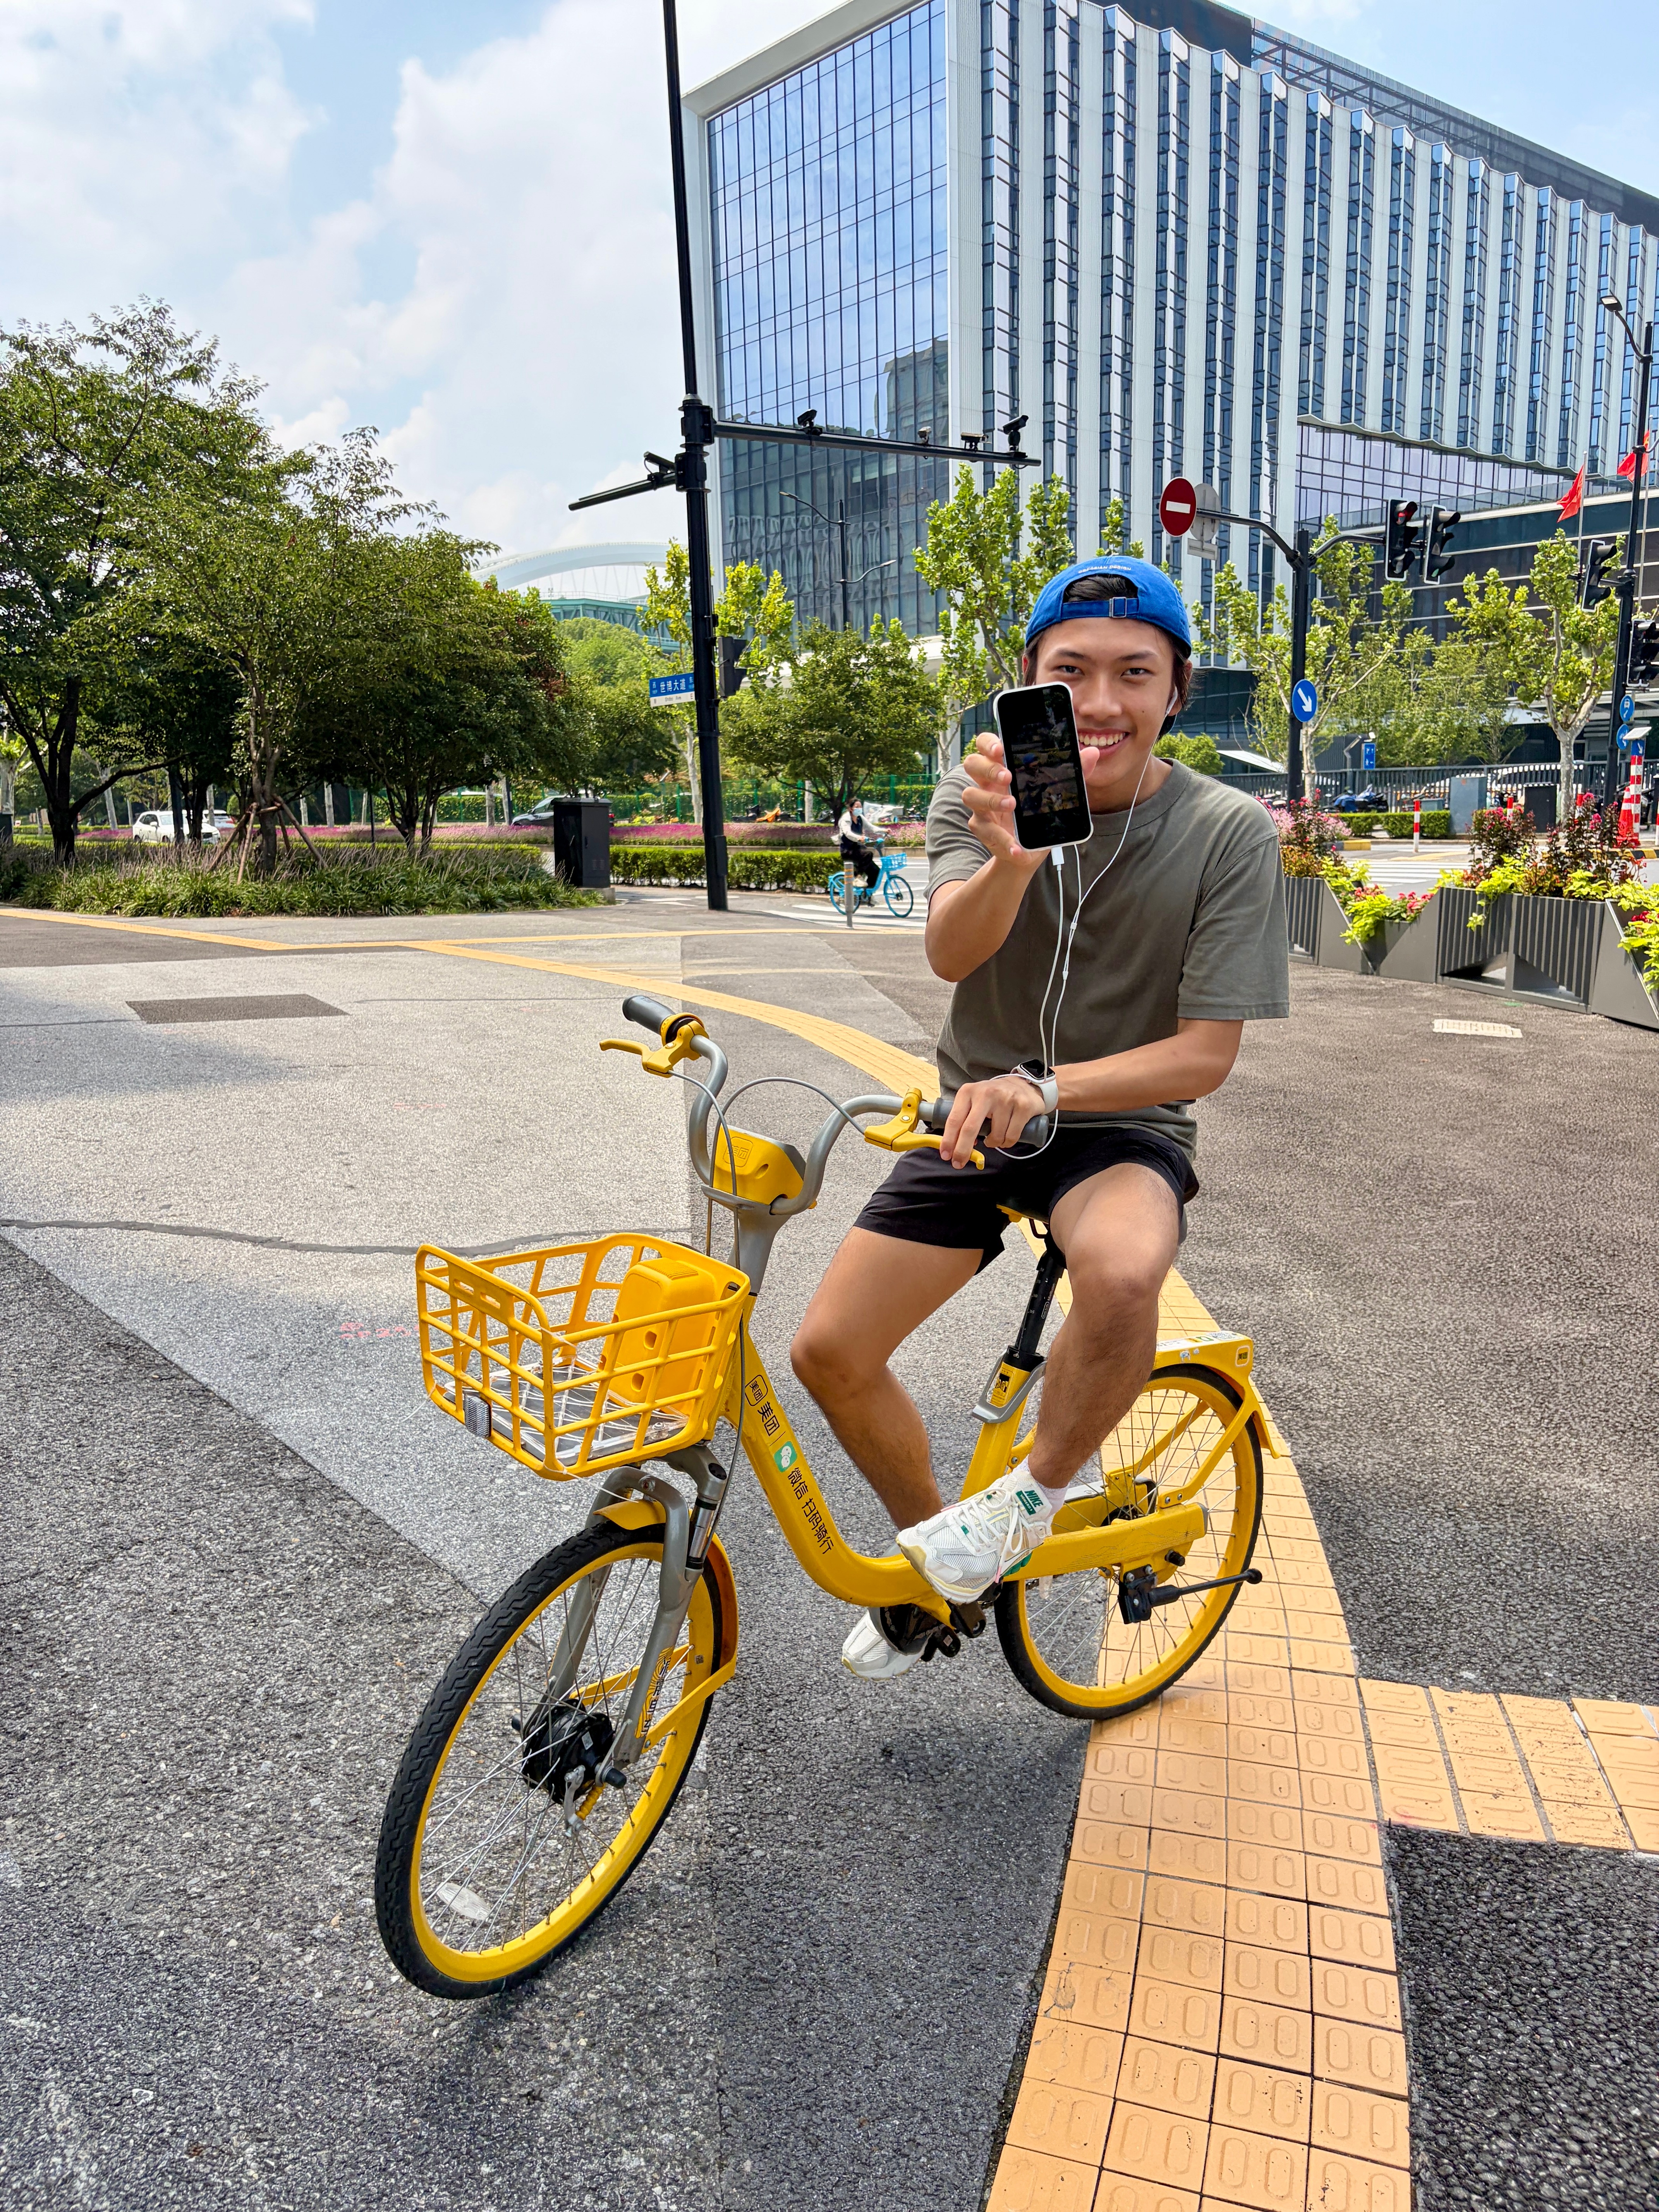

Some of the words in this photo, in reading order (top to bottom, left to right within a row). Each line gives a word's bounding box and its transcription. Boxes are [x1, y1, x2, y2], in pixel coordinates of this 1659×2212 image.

[660, 678, 686, 692] 世博大道
[749, 1380, 764, 1401] 美团
[757, 1401, 780, 1437] 美团
[1025, 1490, 1043, 1507] NIKE
[787, 1467, 809, 1501] 微信
[801, 1498, 835, 1554] 扫码骑行
